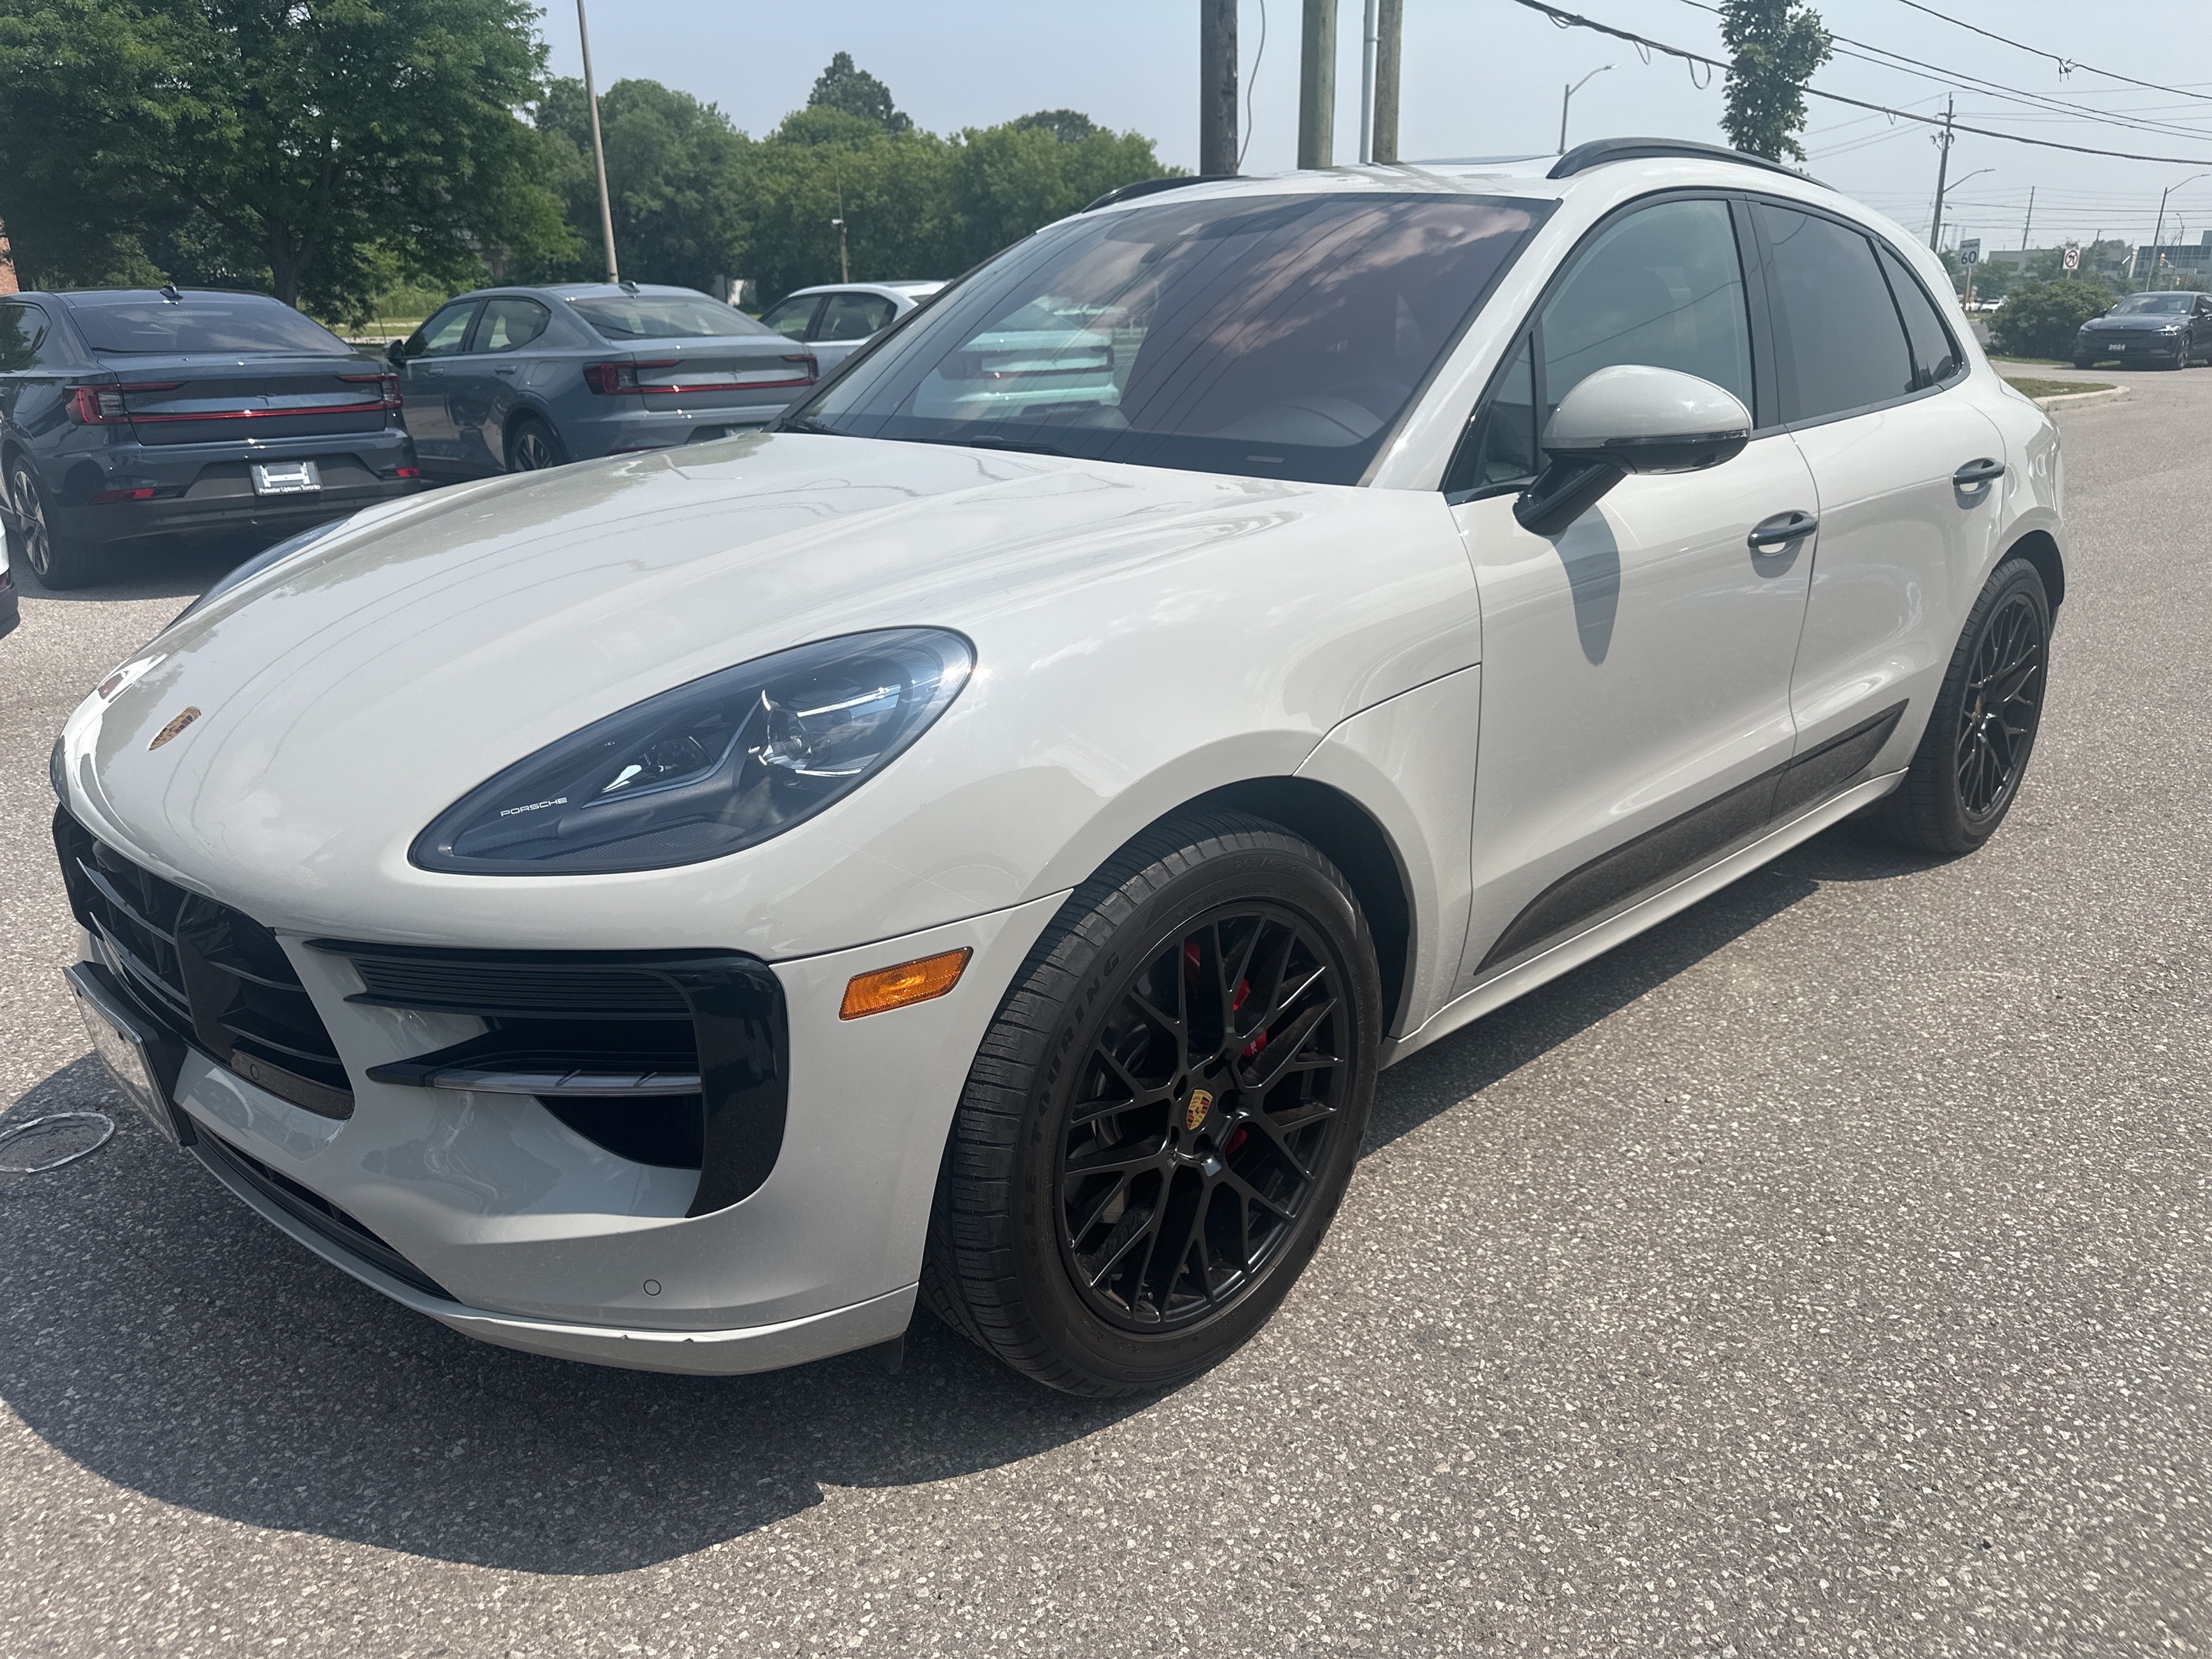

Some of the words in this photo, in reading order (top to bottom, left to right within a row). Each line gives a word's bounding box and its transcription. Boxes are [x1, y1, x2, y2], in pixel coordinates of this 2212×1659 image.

[1961, 250, 1977, 265] 60
[500, 796, 568, 817] PORSCHE
[1030, 951, 1121, 1147] TOURING
